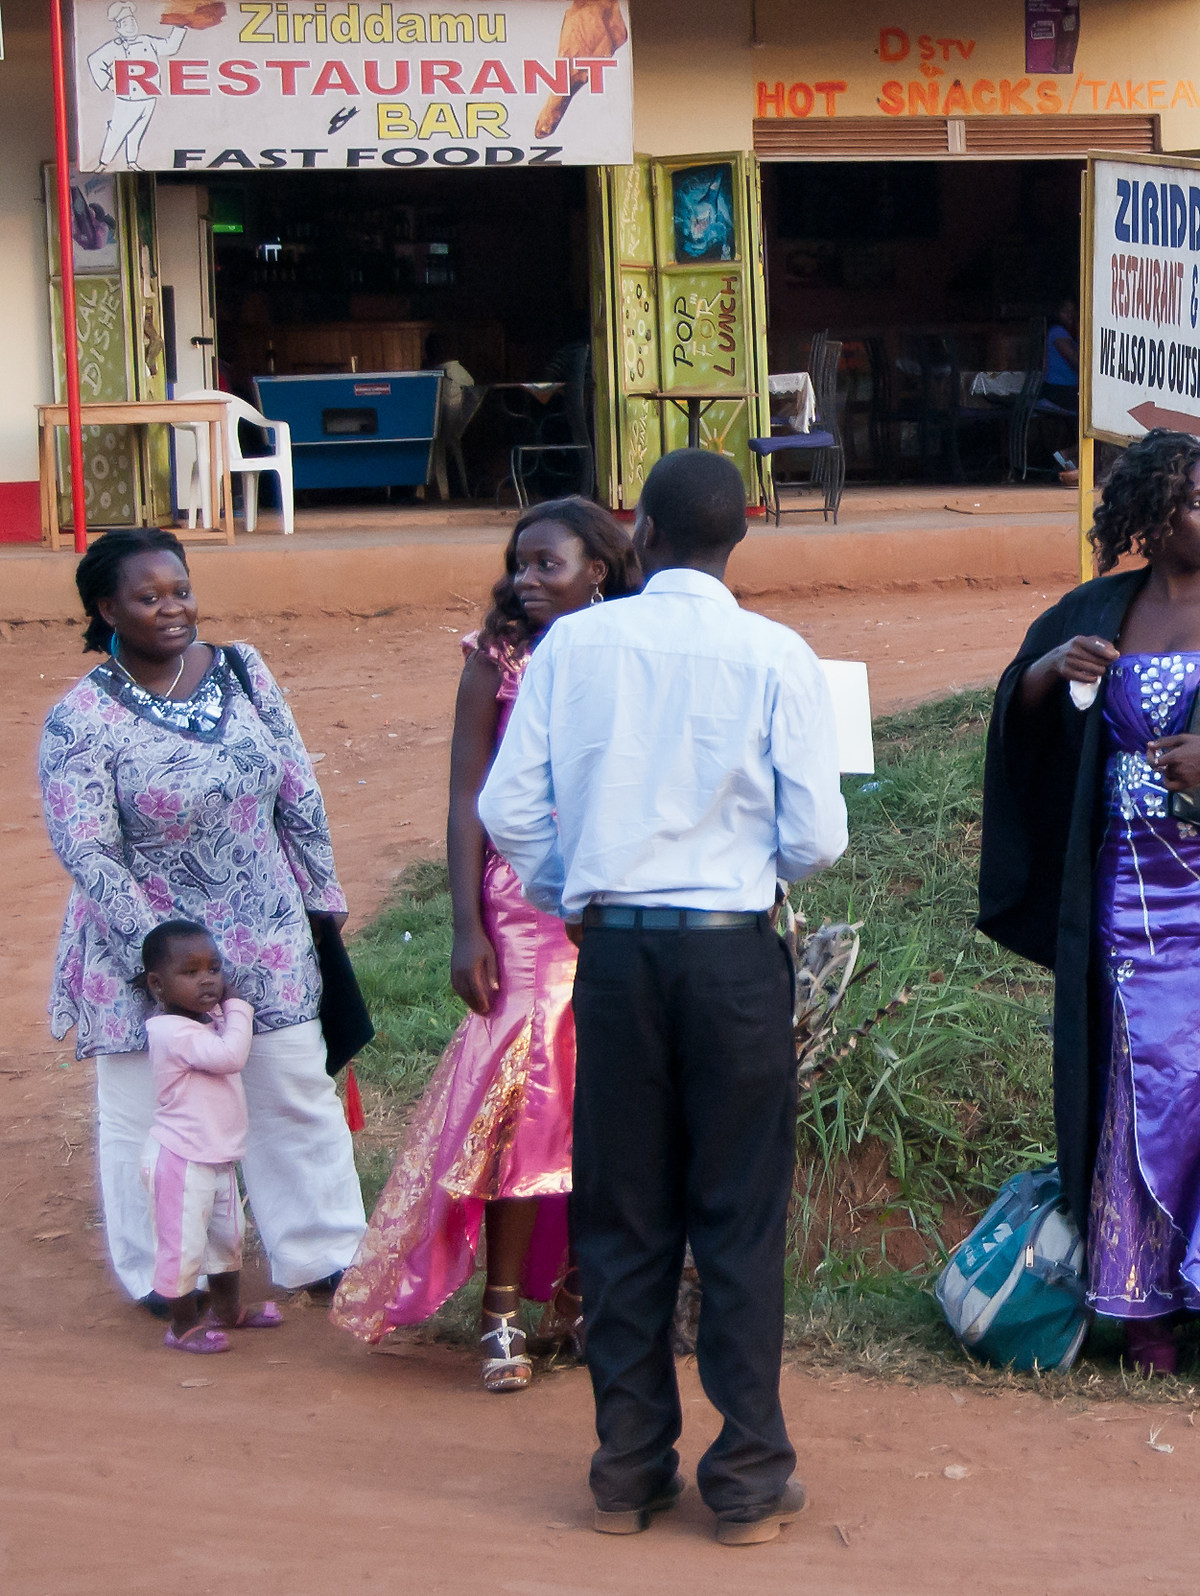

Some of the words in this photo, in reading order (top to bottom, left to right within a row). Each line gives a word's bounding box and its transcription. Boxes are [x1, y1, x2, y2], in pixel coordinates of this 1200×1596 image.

[239, 2, 507, 44] Ziriddamu
[113, 59, 619, 96] RESTAURANT
[756, 80, 848, 118] HOT
[376, 101, 512, 140] BAR
[172, 148, 329, 169] FAST
[346, 146, 564, 168] FOODZ
[1110, 253, 1184, 329] RESTAURANT
[672, 295, 696, 368] POP
[712, 276, 738, 377] LUNCH
[1100, 326, 1117, 378] WE
[1117, 331, 1146, 386] ALSO
[1147, 338, 1165, 391] DO
